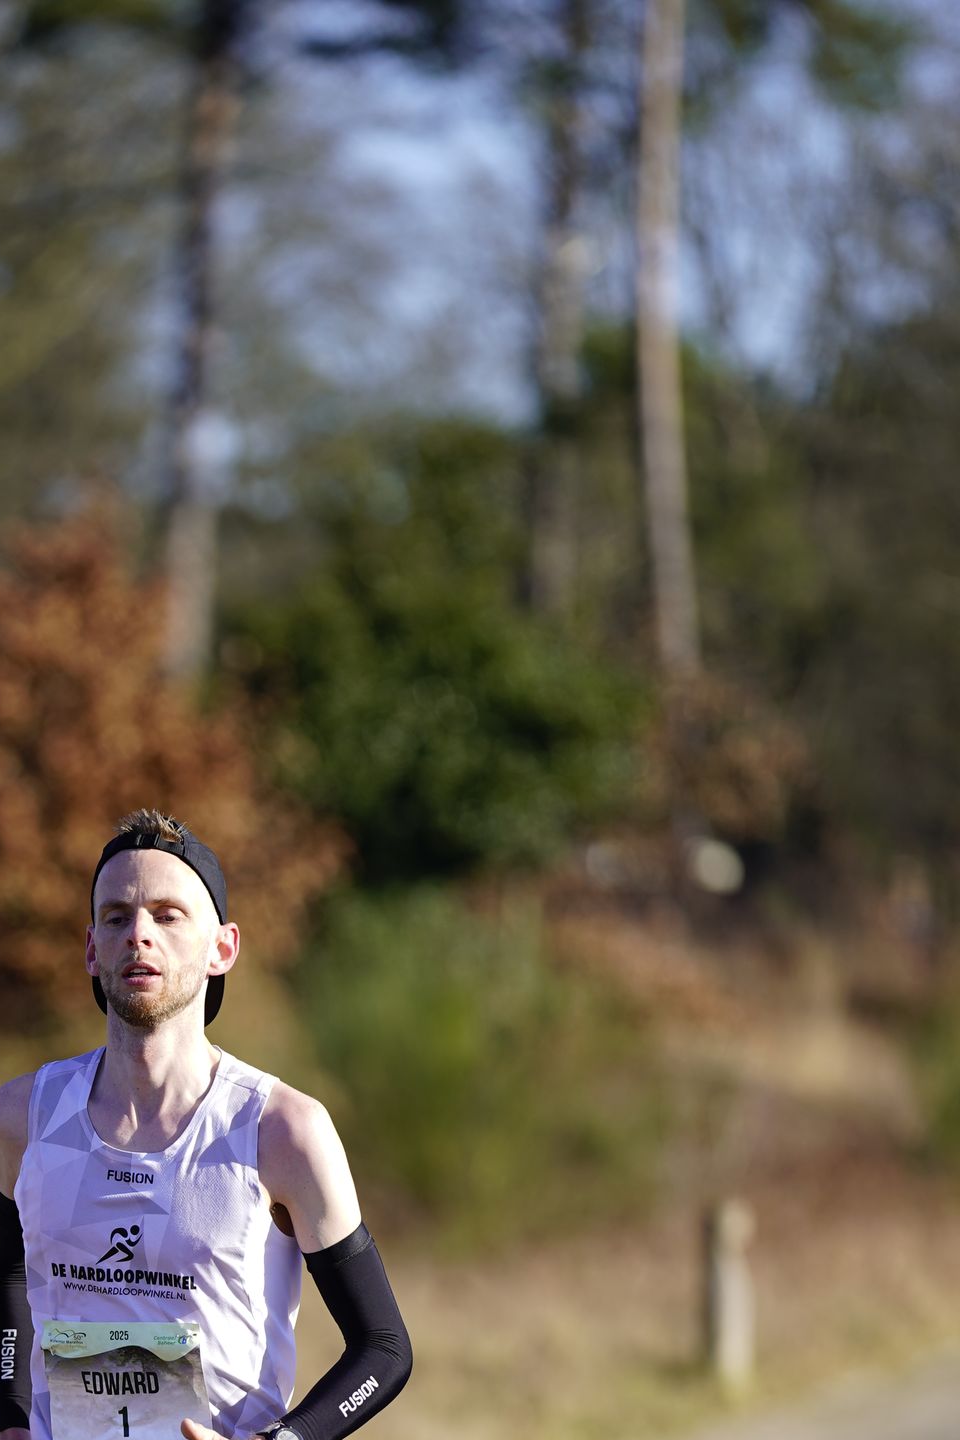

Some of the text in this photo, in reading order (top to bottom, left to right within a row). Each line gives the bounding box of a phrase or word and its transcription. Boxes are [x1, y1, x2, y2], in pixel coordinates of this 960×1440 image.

[106, 1169, 154, 1184] FUSION
[51, 1262, 197, 1290] DE HARDLOOPWINKEL
[63, 1282, 187, 1301] WWW.DEHARDLOOPWINKEL.NL
[109, 1330, 129, 1341] 2025
[1, 1328, 18, 1380] FUSION
[81, 1371, 160, 1396] EDWARD
[338, 1375, 379, 1418] FUSION
[118, 1406, 130, 1438] 1
